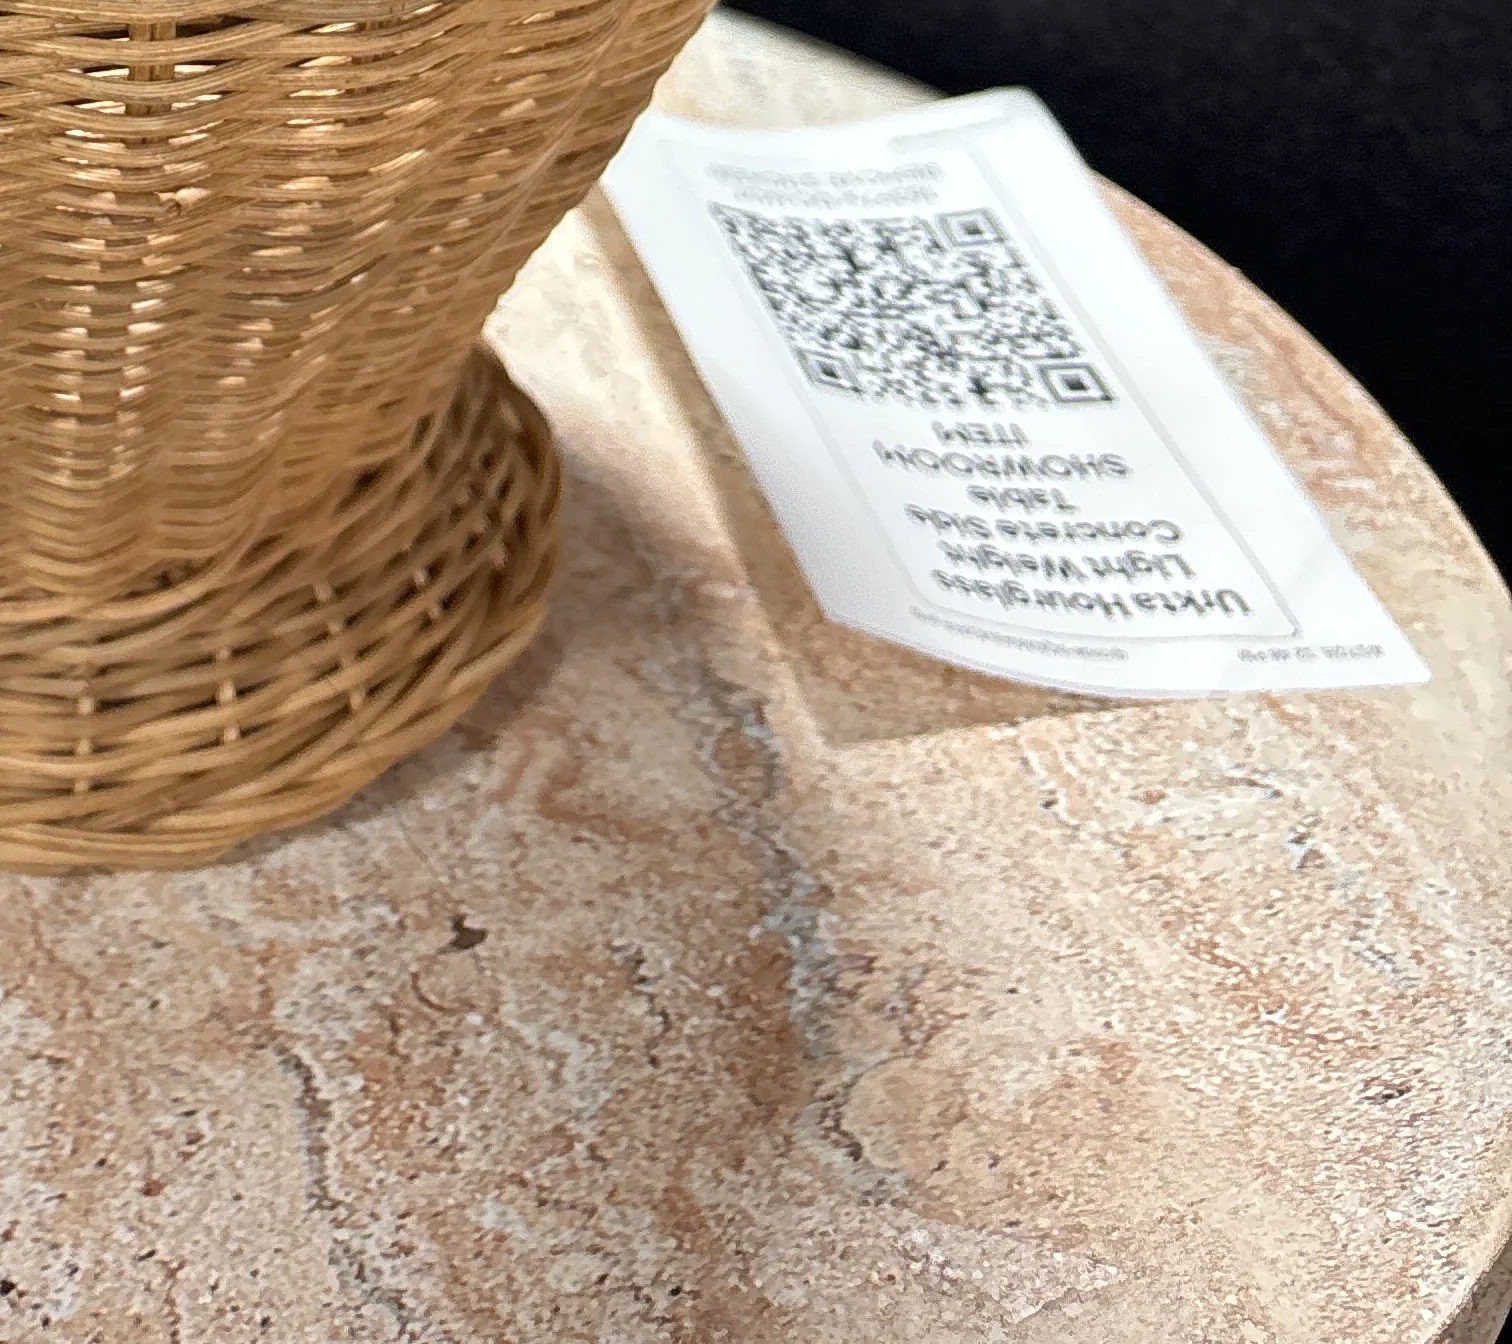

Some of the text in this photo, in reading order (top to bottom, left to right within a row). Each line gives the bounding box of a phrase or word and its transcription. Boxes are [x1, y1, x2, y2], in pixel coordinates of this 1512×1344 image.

[931, 421, 1031, 448] ITEM
[872, 439, 1134, 481] SHOWROOM
[966, 485, 1082, 514] Table
[904, 503, 1184, 547] Concrete Side
[937, 539, 1196, 583] Light Weight
[930, 568, 1254, 619] Urkta Hourglass
